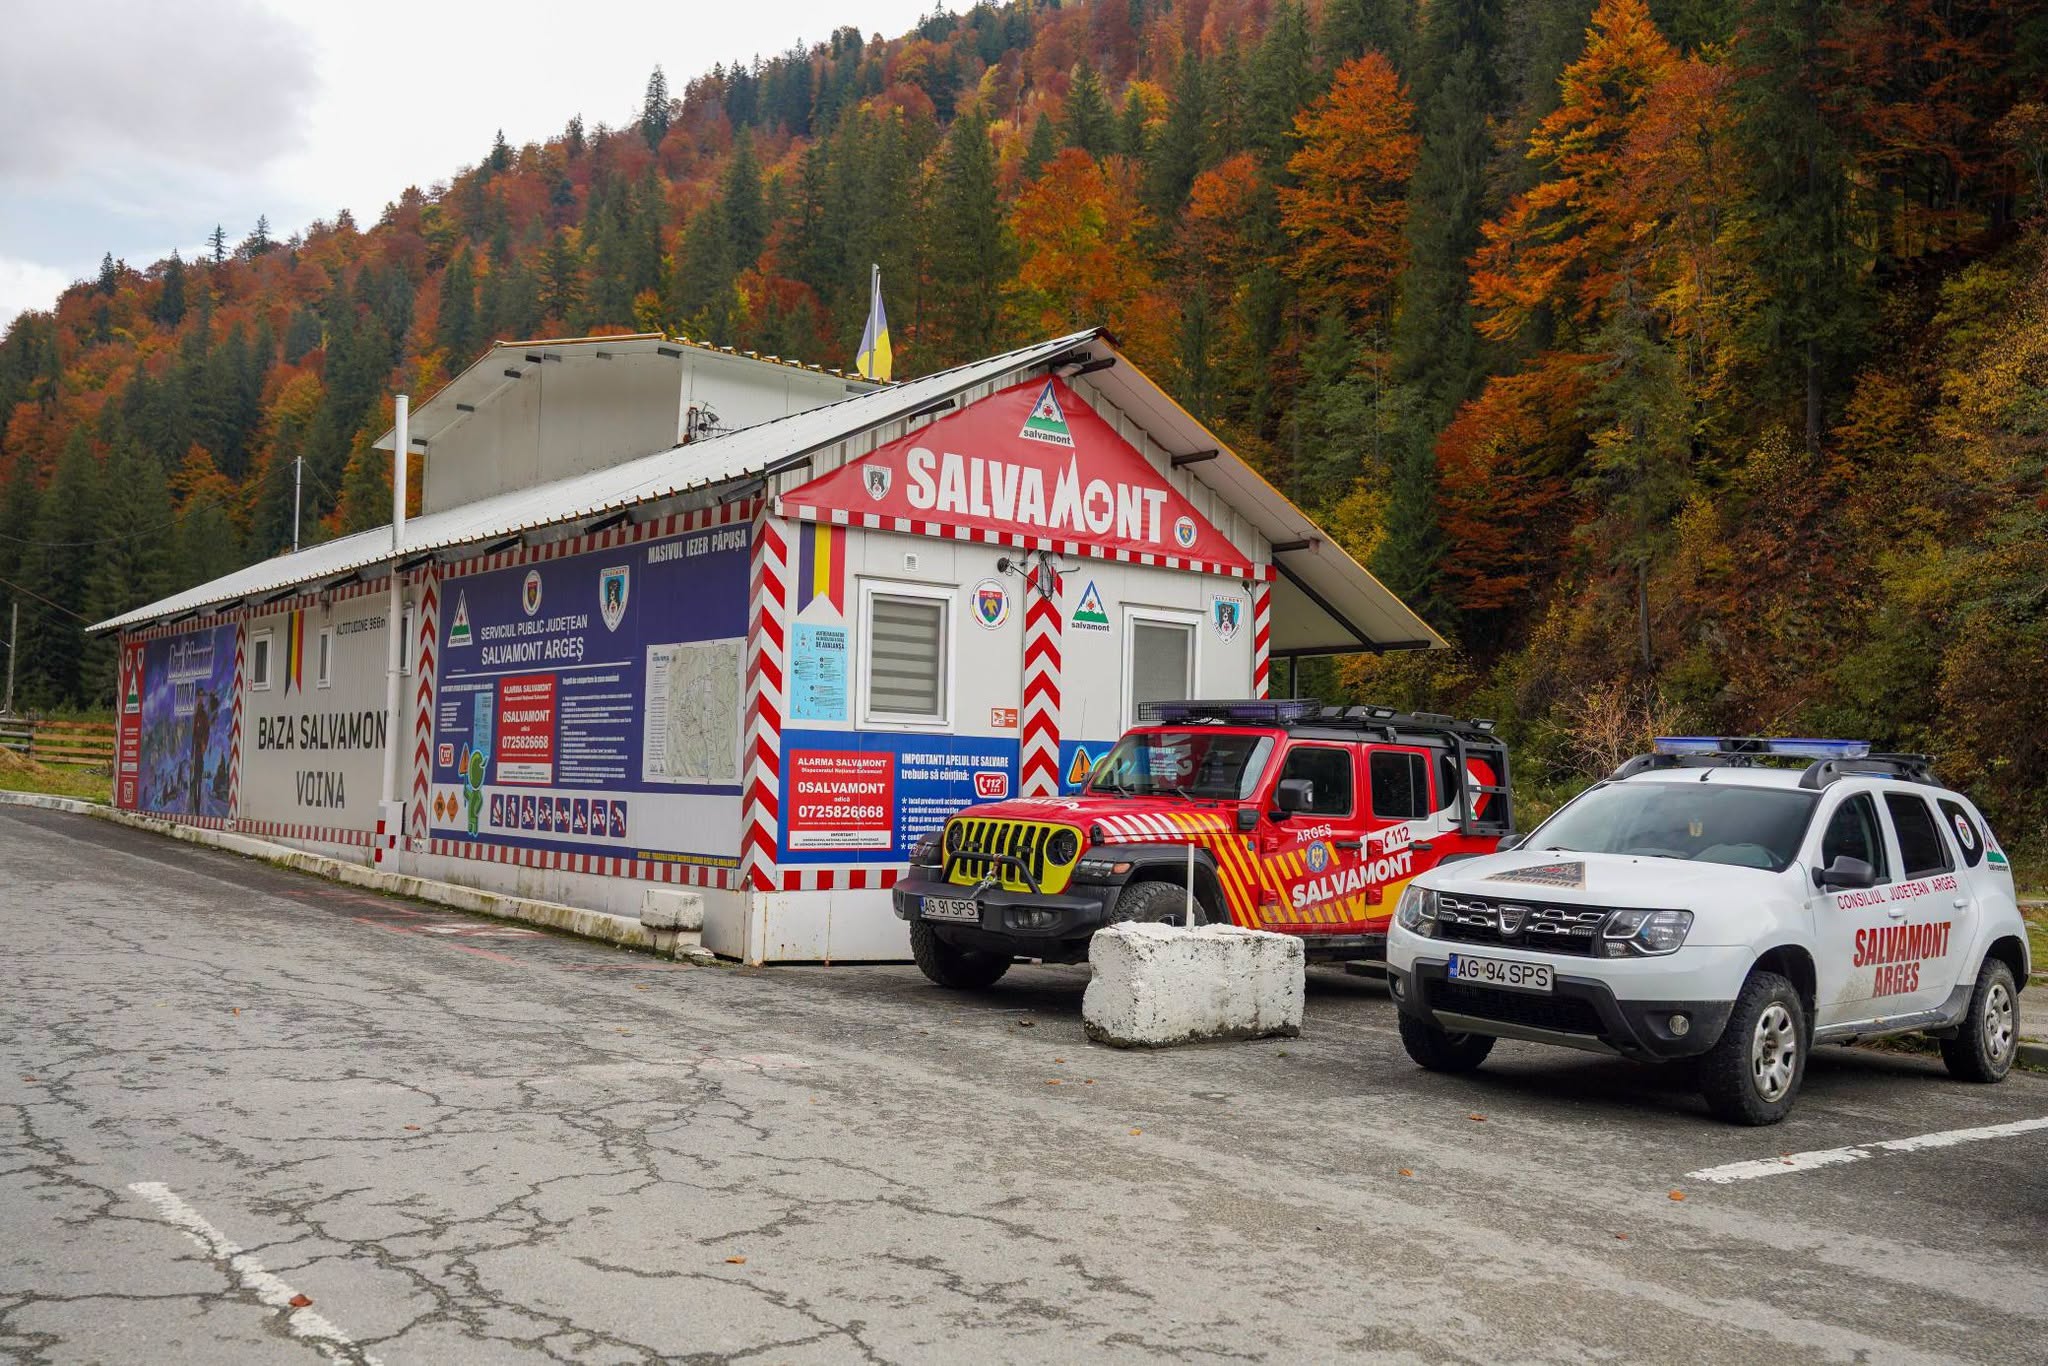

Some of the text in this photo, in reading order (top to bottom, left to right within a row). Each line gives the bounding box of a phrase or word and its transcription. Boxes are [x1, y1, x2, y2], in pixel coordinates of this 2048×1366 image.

[1023, 427, 1071, 445] salvamont
[906, 447, 1168, 544] SALVAMONT
[648, 541, 683, 564] MASIVUL
[686, 536, 709, 557] IEZER
[480, 625, 516, 640] SERVICIUL
[517, 621, 544, 637] PUBLIC
[1071, 621, 1110, 632] salvamont
[481, 641, 543, 666] SALVAMONT
[523, 683, 552, 693] SALVAMONT
[258, 715, 294, 750] BAZA
[300, 710, 400, 750] SALVAMON
[502, 735, 549, 749] 0725826668
[797, 757, 887, 767] ALARMA SALVAMONT
[945, 754, 970, 766] APELUL
[970, 755, 980, 767] DE
[980, 756, 1009, 768] SALVARE
[901, 768, 929, 780] trebuie
[985, 778, 1001, 788] 112
[296, 770, 345, 809] VOINA
[798, 805, 884, 819] 0725826668
[1391, 826, 1411, 845] 112
[1292, 850, 1413, 908] SALVAMONT
[924, 900, 975, 917] AG 91 SPS
[1837, 890, 1886, 910] CONSILIUL
[1853, 921, 1952, 968] SALVAMONT
[1458, 958, 1479, 978] AG
[1486, 962, 1505, 982] 94
[1509, 964, 1548, 986] SPS
